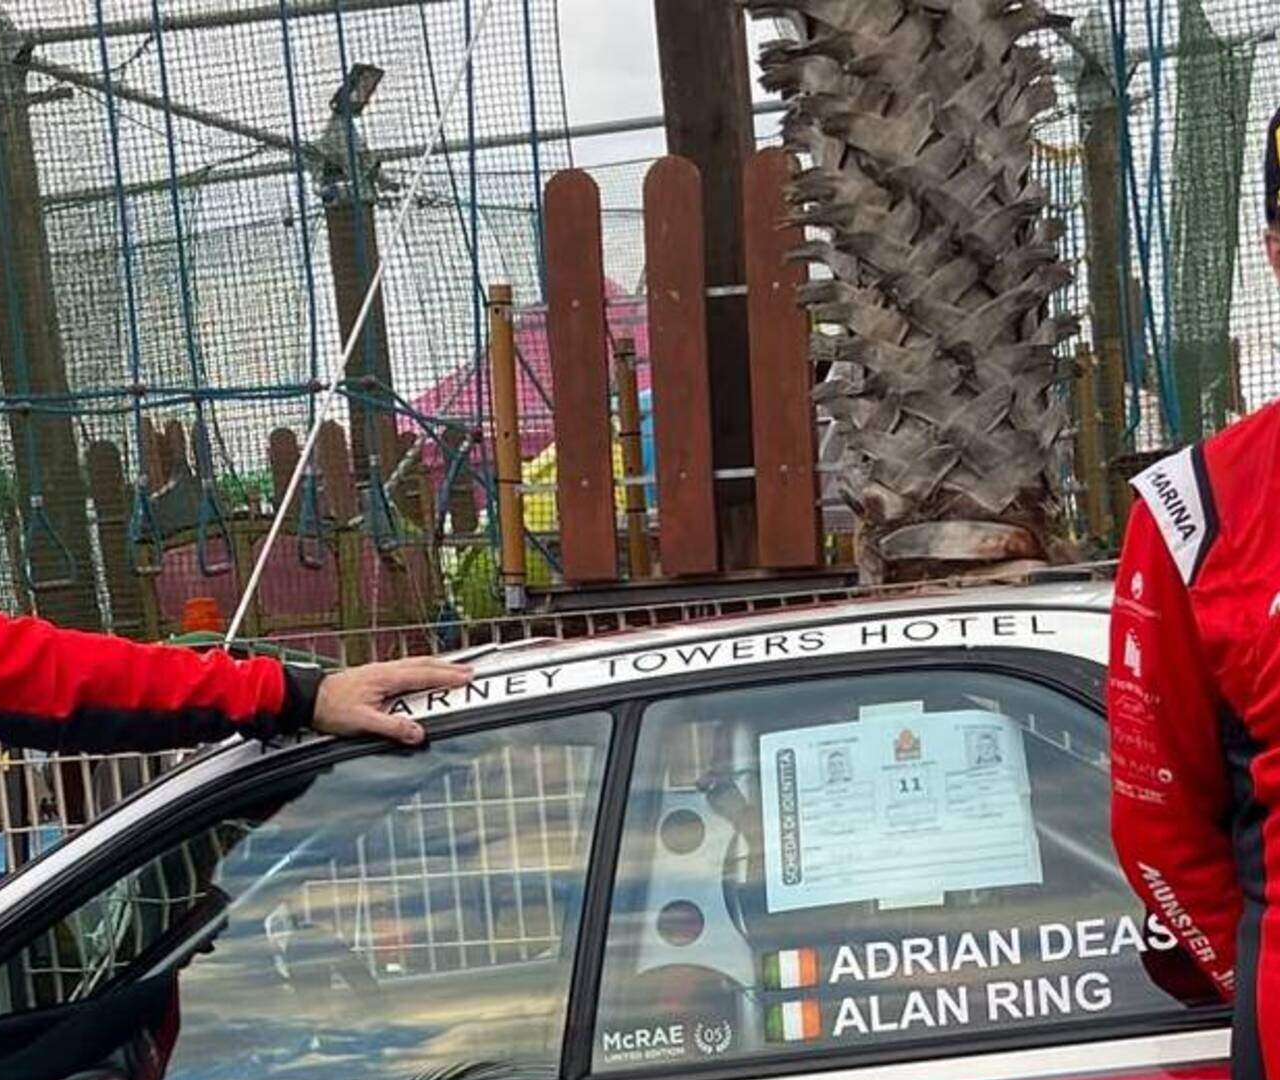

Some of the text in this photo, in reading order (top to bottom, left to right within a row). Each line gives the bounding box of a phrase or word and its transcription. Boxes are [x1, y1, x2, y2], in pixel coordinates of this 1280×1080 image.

[601, 630, 826, 679] TOWERS
[859, 612, 1060, 647] HOTEL
[897, 776, 923, 793] 11
[1136, 860, 1217, 963] MUNSTER
[828, 911, 1180, 985] ADRIAN DEAS
[831, 971, 1113, 1037] ALAN RING
[602, 1024, 723, 1051] McRAE 05
